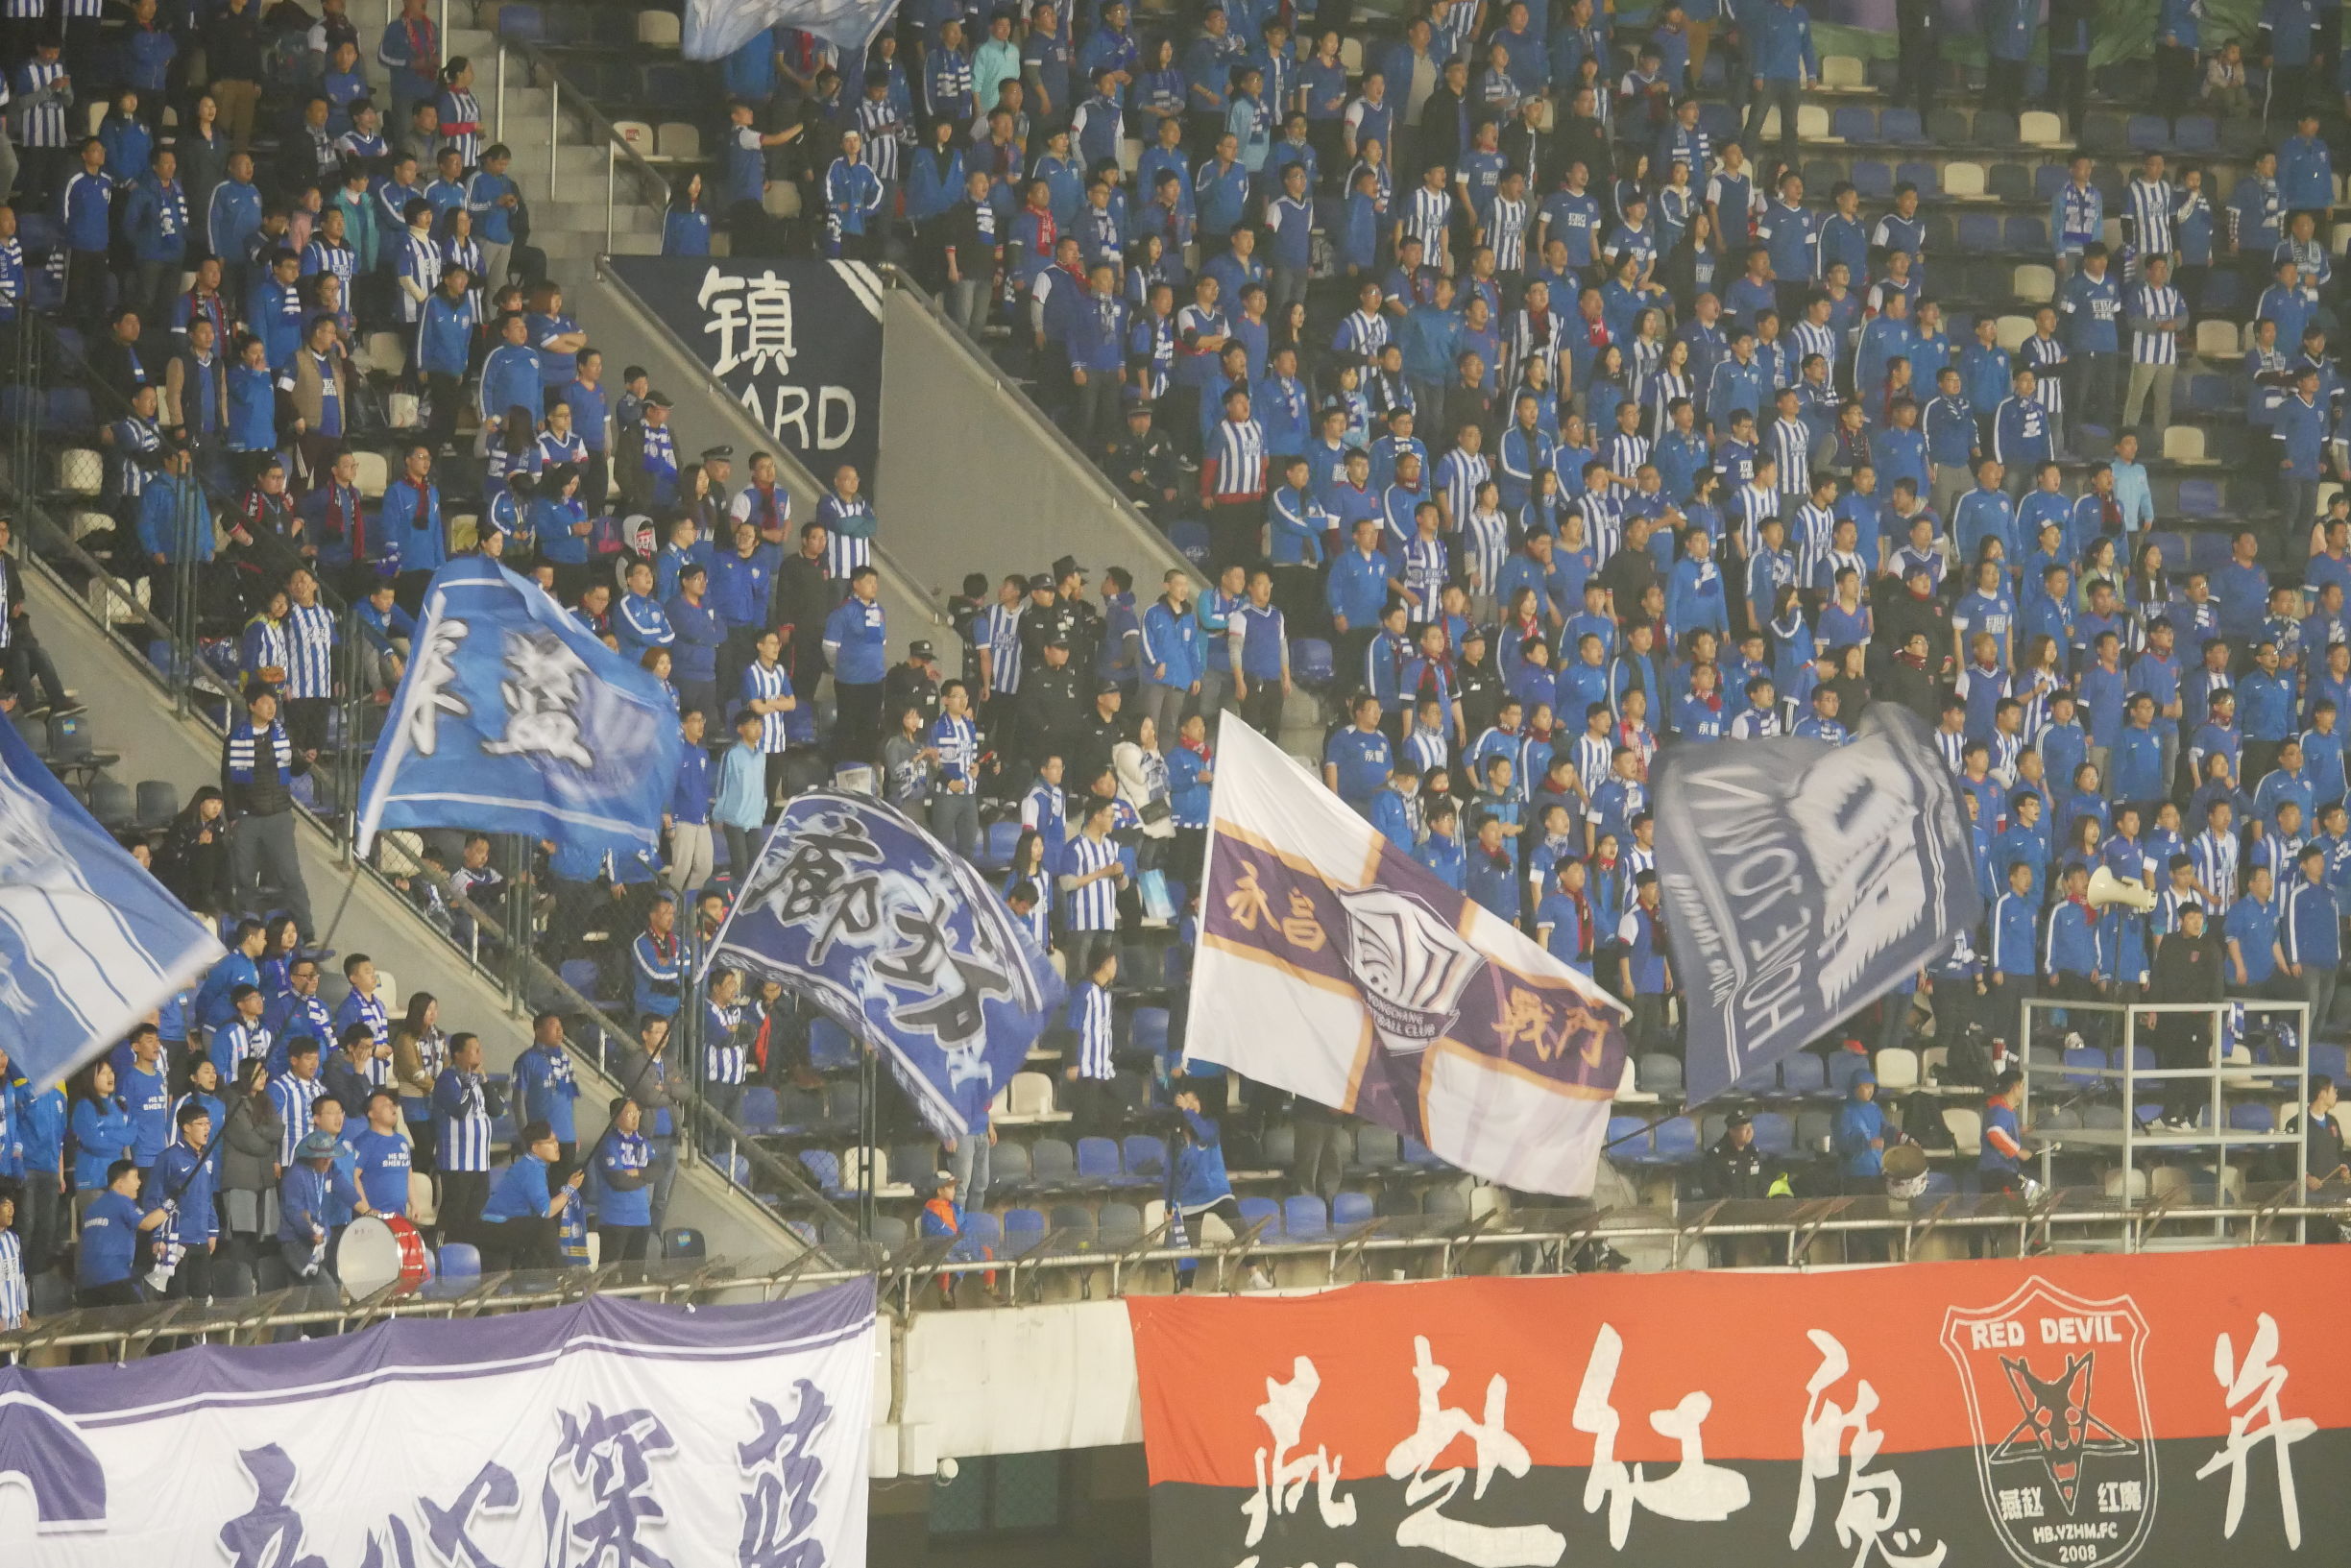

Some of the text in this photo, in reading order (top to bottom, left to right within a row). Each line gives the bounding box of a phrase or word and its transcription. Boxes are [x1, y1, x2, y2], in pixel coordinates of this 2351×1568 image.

[739, 383, 856, 449] ARD
[1226, 858, 1327, 952] 永昌
[1971, 1315, 2122, 1350] RED DEVIL
[2059, 1544, 2097, 1563] 2008
